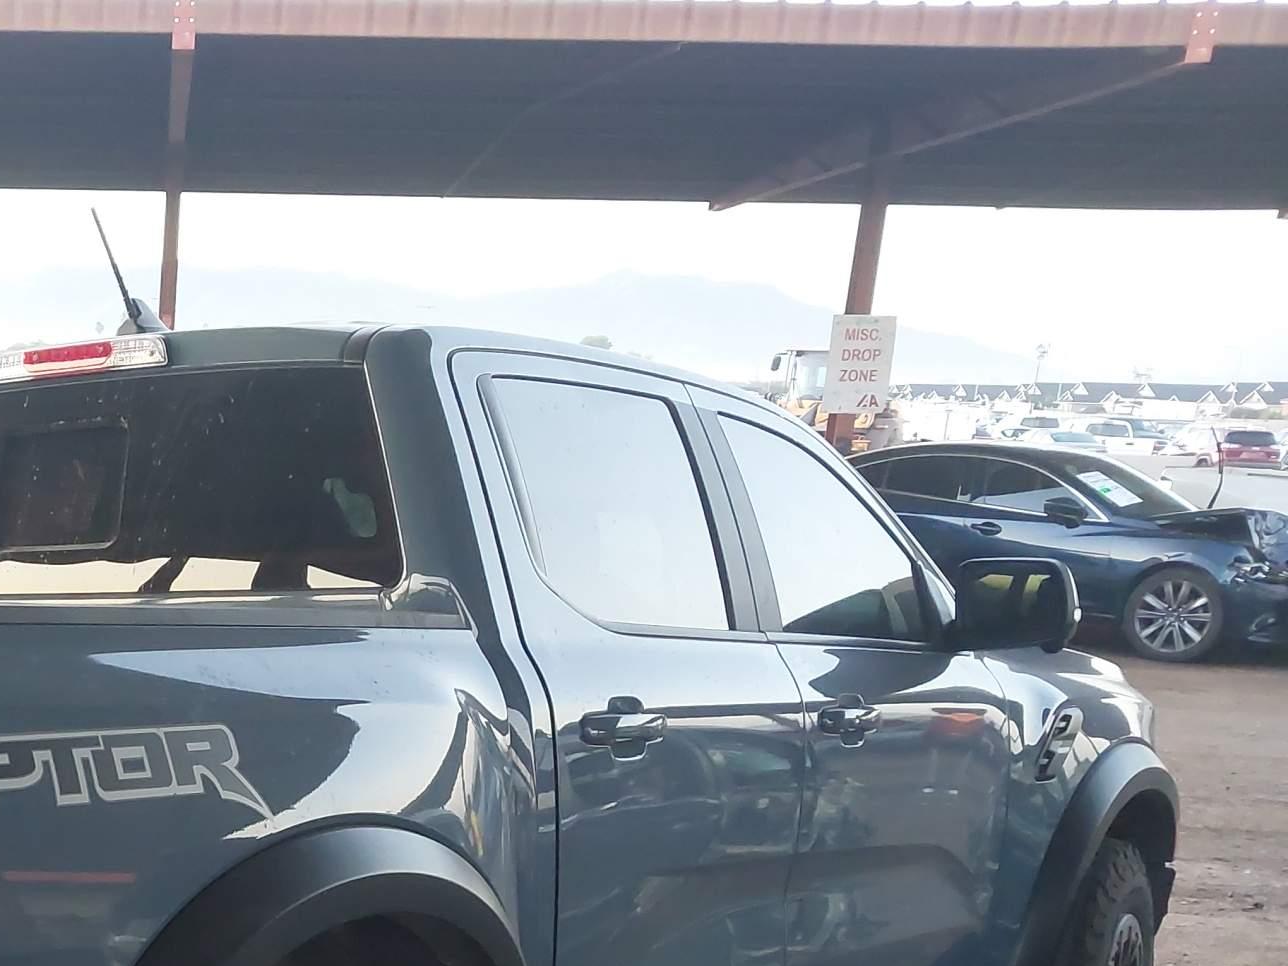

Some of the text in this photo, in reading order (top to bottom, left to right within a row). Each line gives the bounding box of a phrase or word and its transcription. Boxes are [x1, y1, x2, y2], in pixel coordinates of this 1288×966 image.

[844, 327, 883, 341] MISC.
[841, 348, 882, 362] DROP
[839, 369, 878, 382] ZONE
